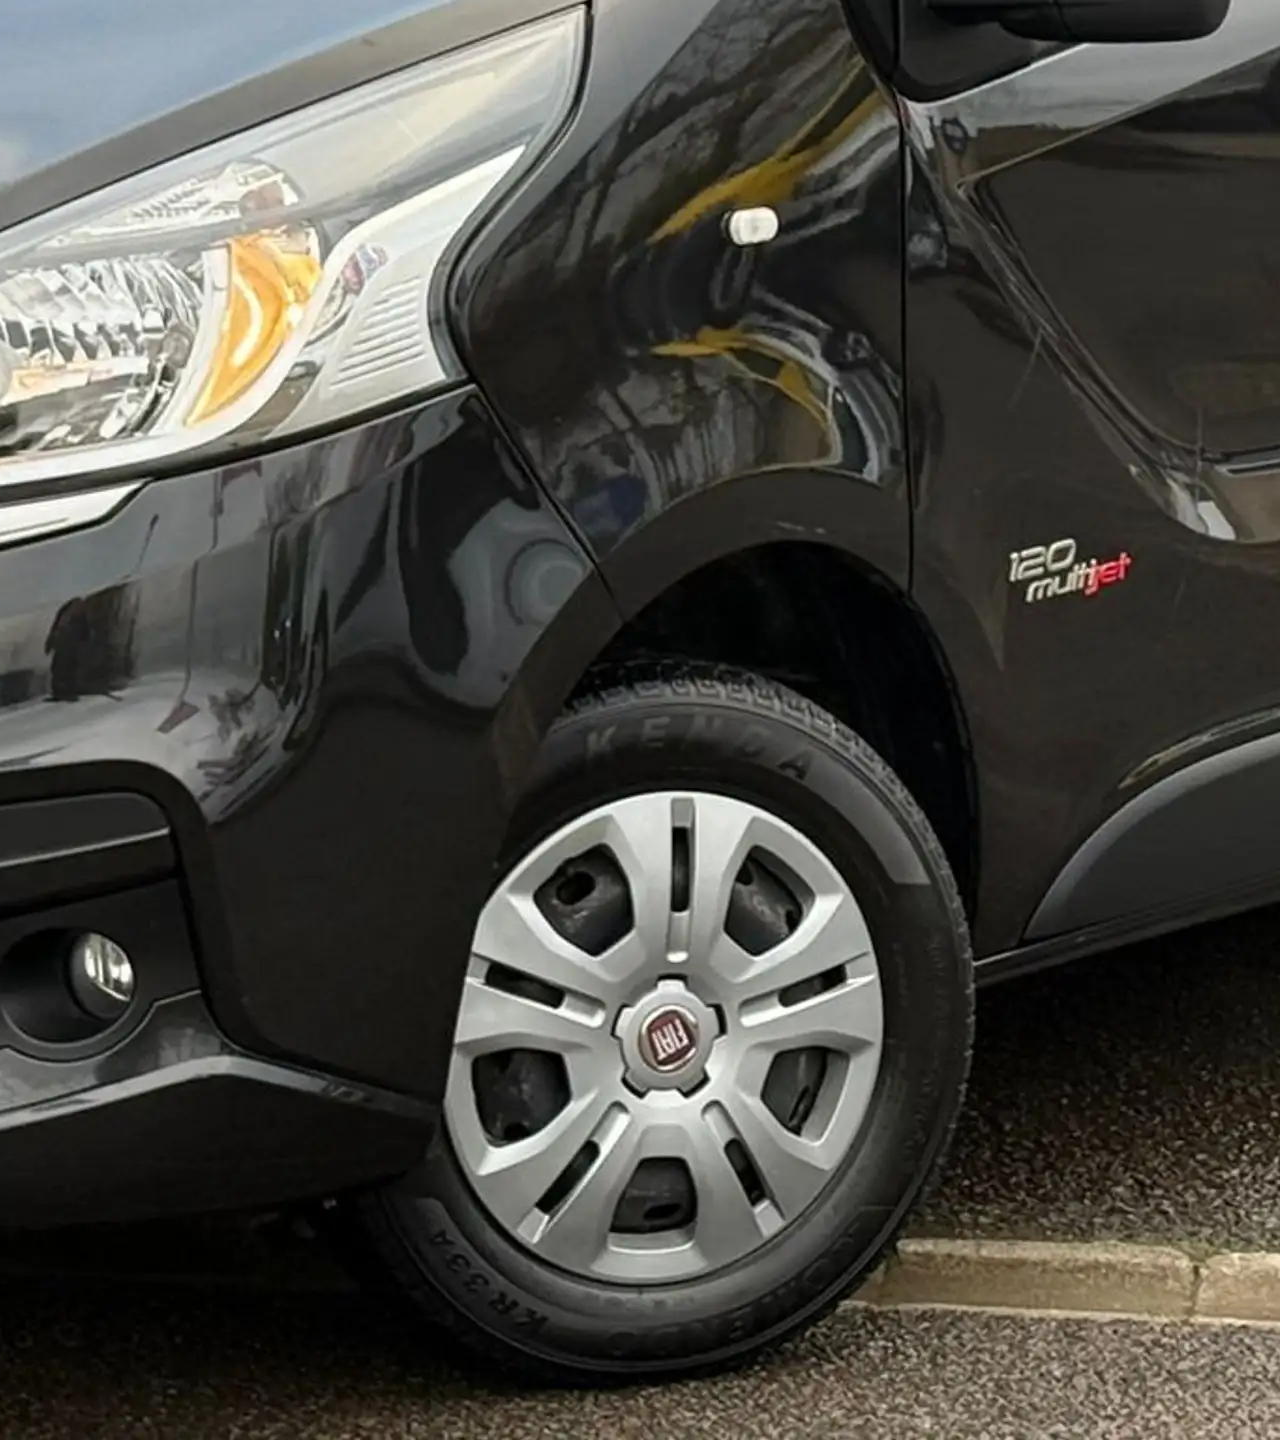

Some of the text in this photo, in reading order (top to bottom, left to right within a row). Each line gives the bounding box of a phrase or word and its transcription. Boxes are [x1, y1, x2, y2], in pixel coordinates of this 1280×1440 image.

[1009, 538, 1077, 582] 120
[1025, 551, 1132, 603] multijet
[583, 710, 815, 782] KENDA
[650, 1018, 691, 1062] FIAT
